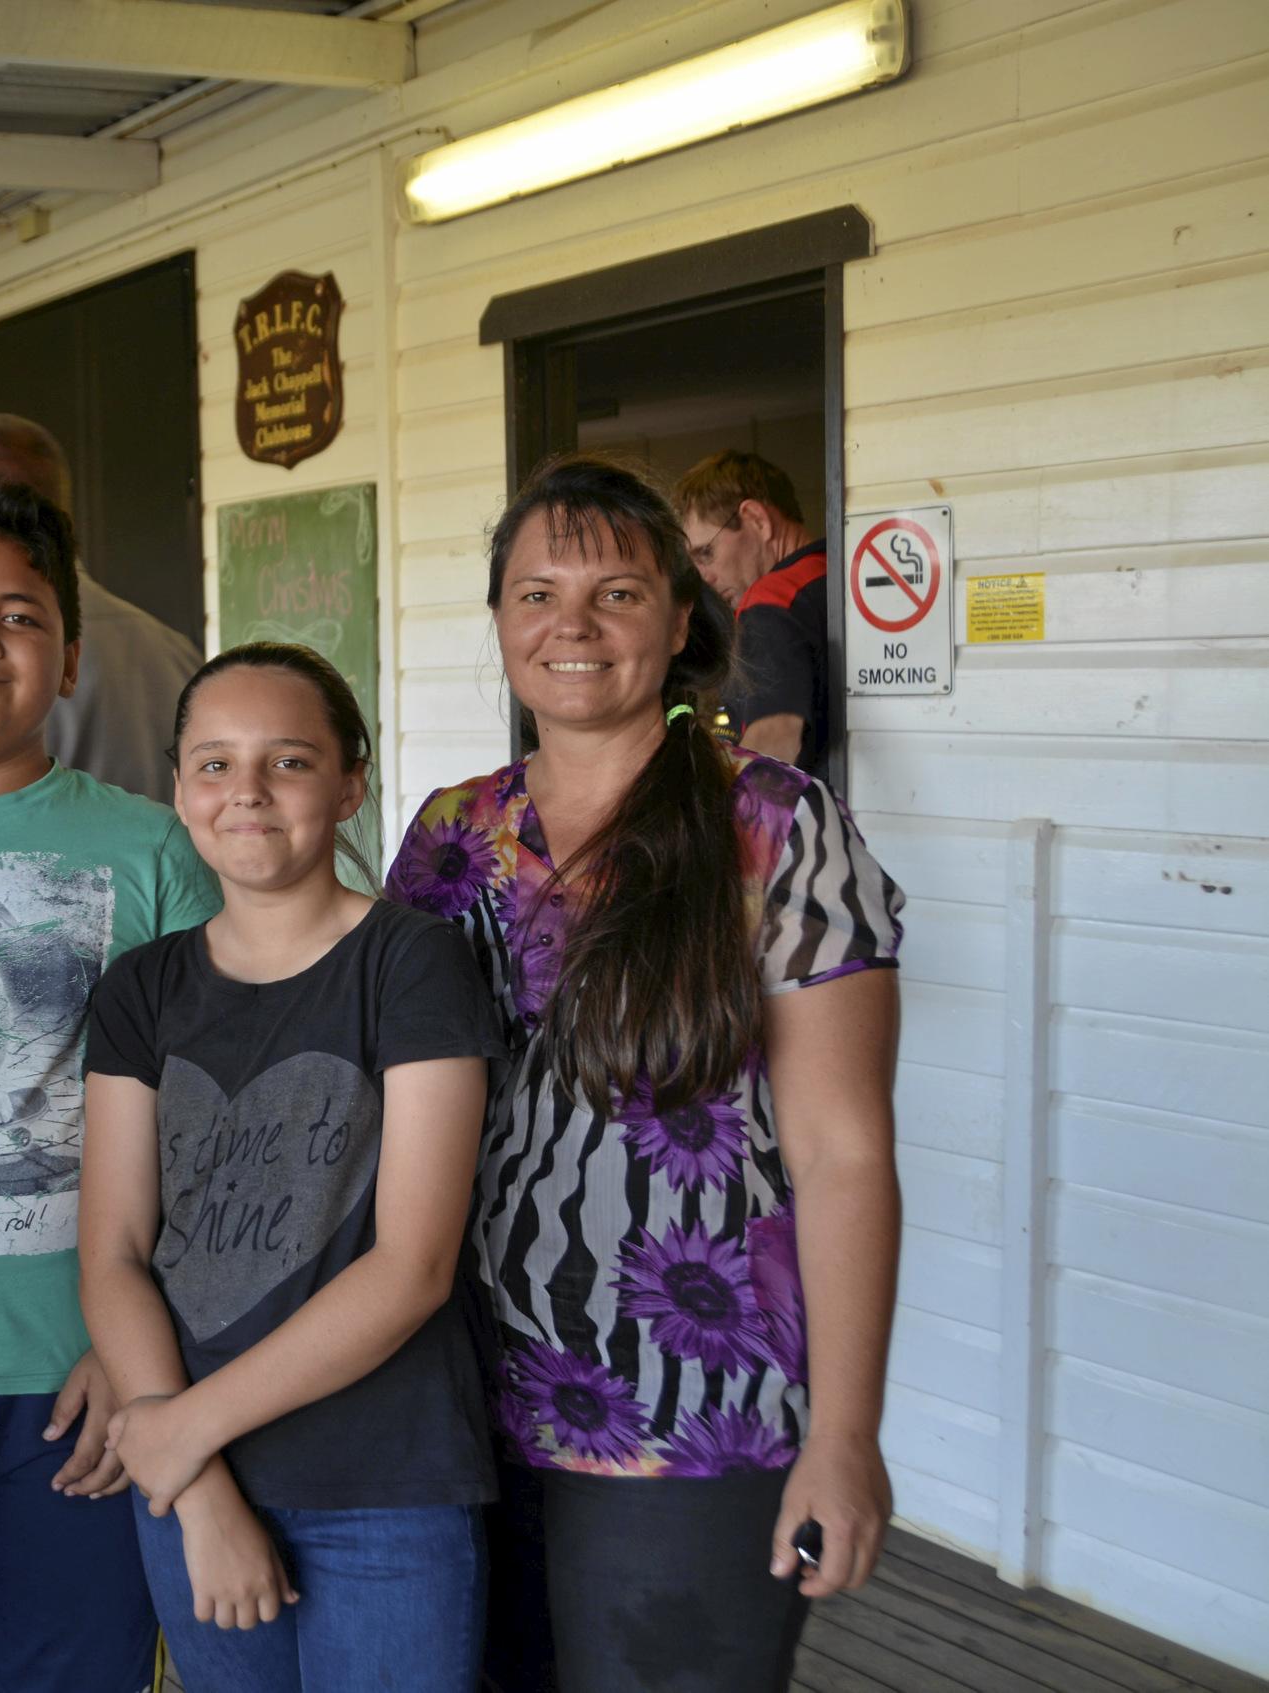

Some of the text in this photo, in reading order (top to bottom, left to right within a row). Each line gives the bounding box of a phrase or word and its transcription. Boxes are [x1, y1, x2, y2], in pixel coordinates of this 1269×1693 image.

[884, 643, 908, 659] NO
[858, 667, 937, 685] SMOKING
[194, 1113, 283, 1175] time
[307, 1097, 351, 1166] to
